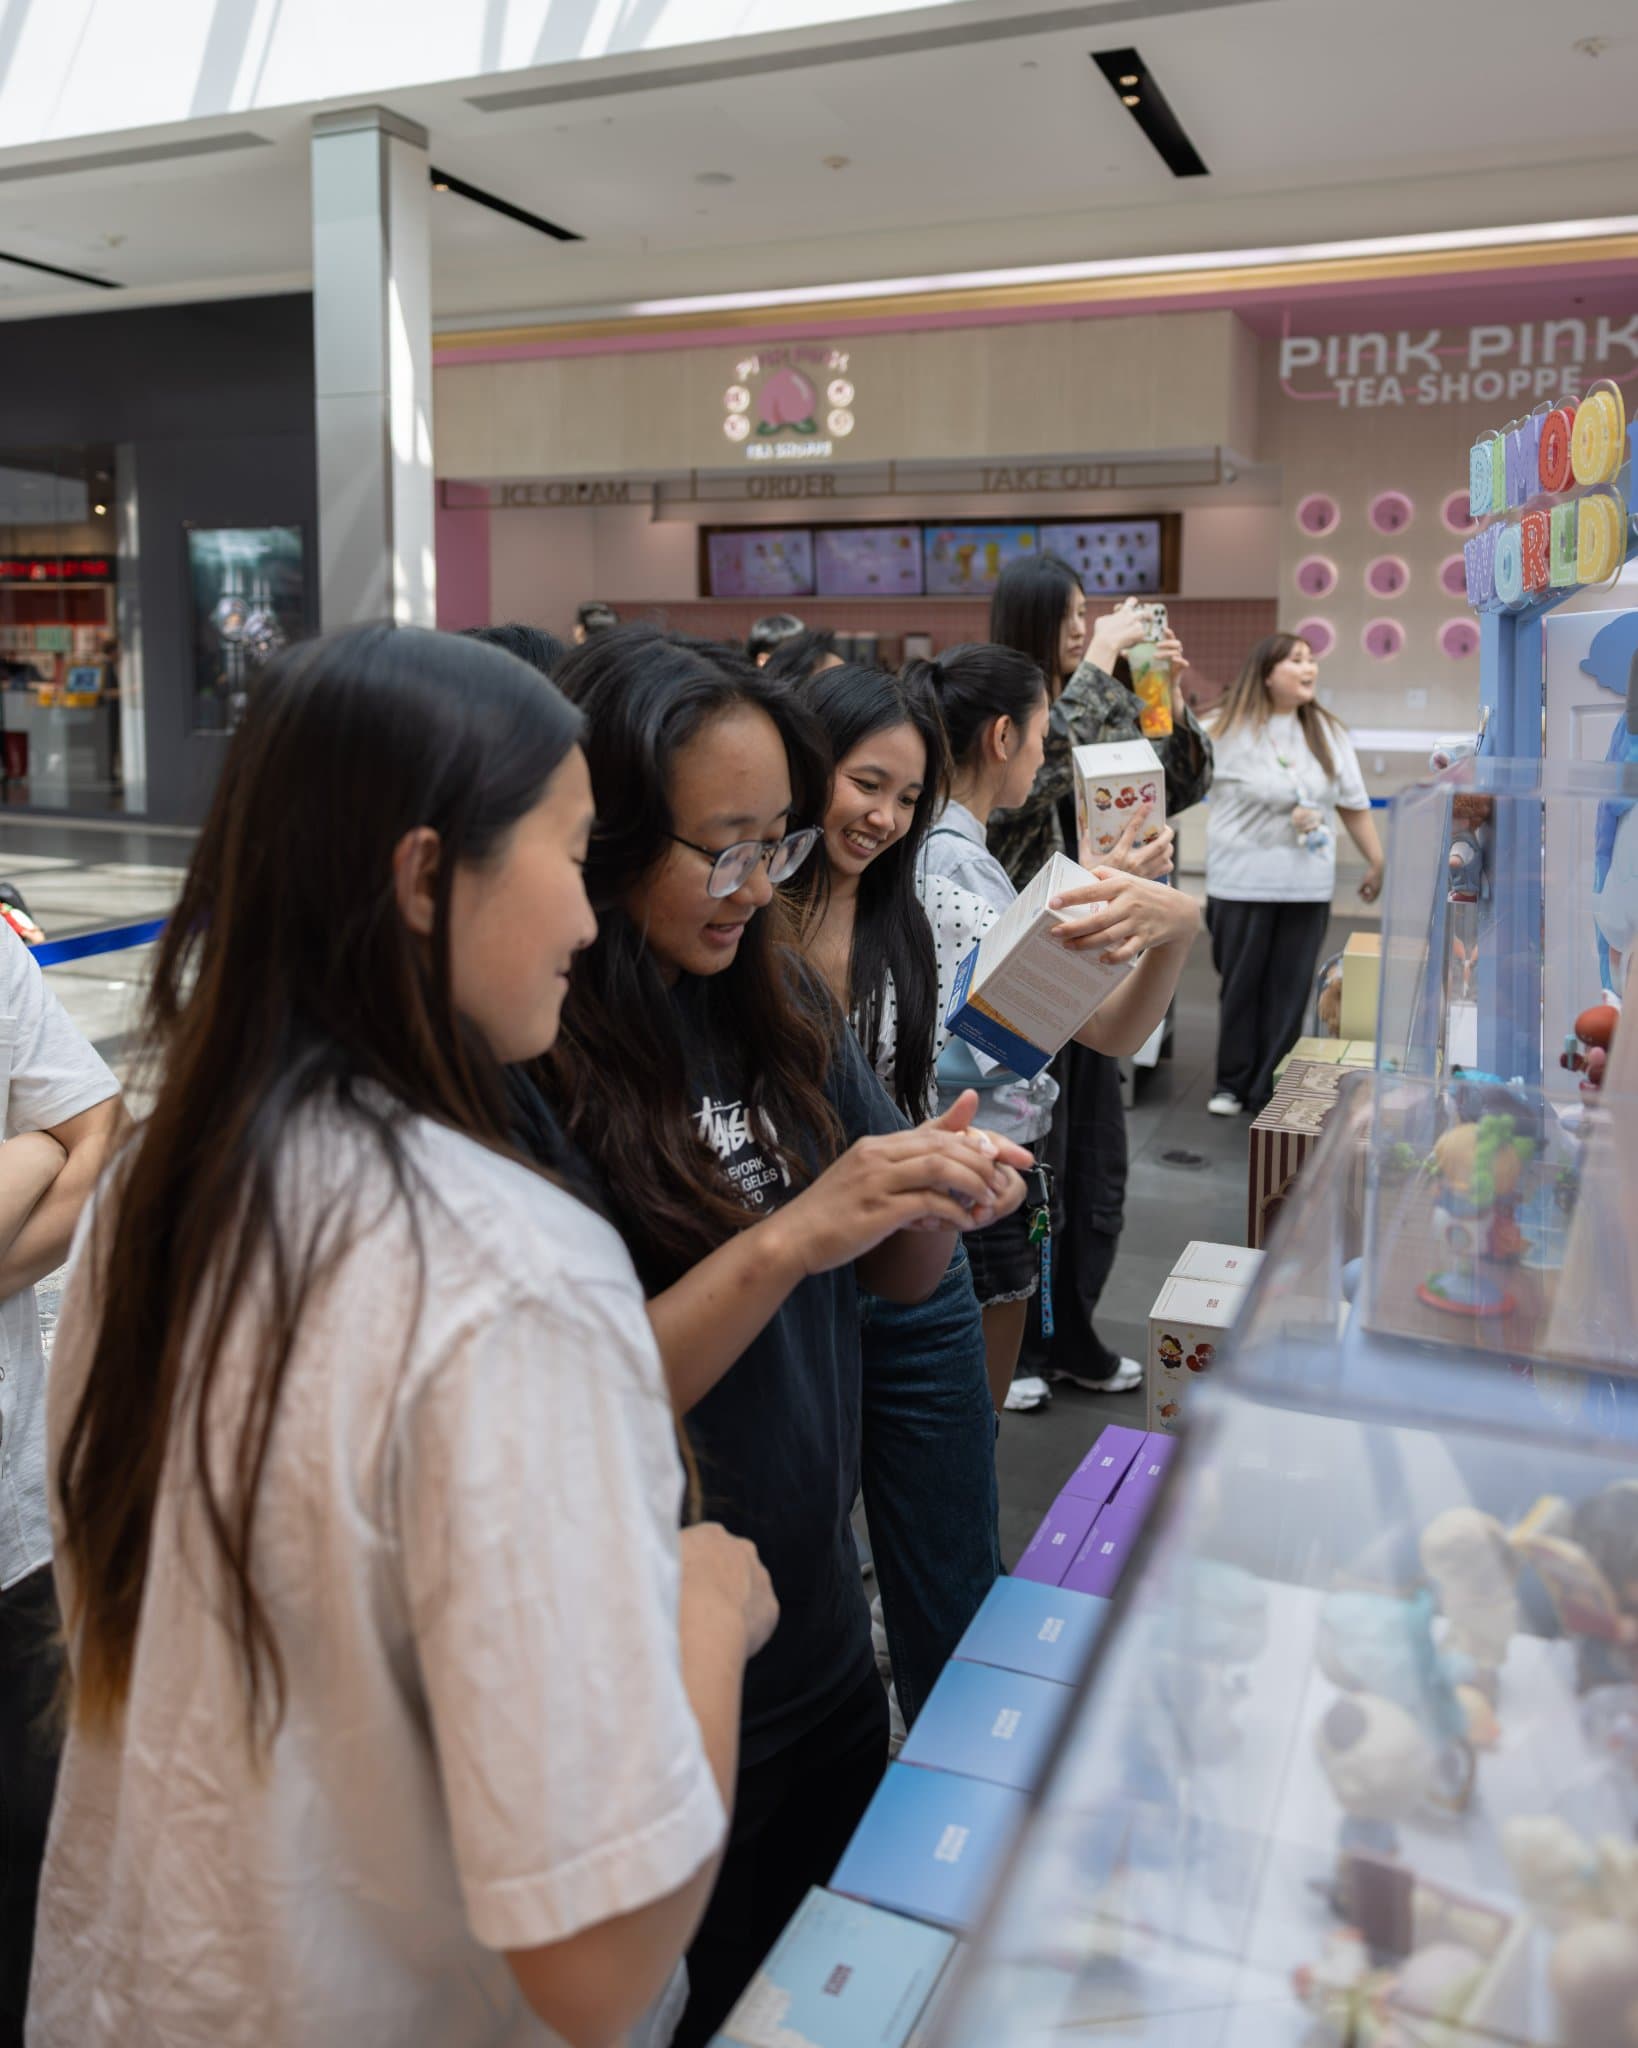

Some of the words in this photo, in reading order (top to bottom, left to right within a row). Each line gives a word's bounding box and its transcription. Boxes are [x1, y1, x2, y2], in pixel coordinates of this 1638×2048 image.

[1334, 377, 1405, 409] TEA
[1417, 366, 1583, 406] SHOPPE
[745, 473, 837, 499] ORDER
[980, 466, 1053, 493] TAKE
[1061, 462, 1118, 489] OUT
[500, 481, 537, 505] ICE
[1464, 495, 1614, 604] WORLD
[741, 1168, 778, 1192] GELES
